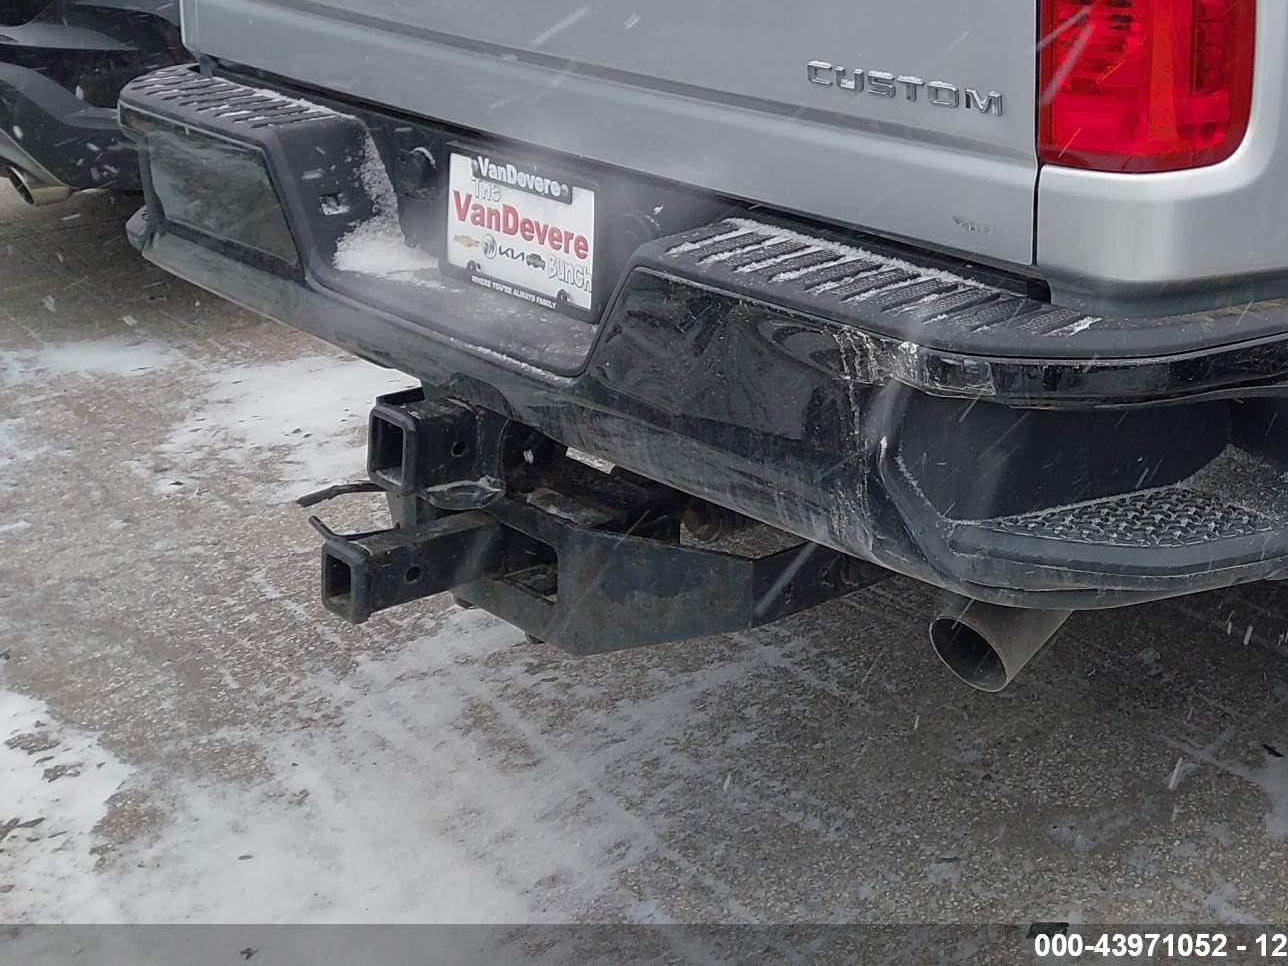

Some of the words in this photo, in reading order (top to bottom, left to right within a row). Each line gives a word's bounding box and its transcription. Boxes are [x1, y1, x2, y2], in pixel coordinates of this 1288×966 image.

[807, 60, 1003, 116] CUSTOM
[477, 156, 562, 197] VanDevere
[453, 190, 588, 260] VanDevere
